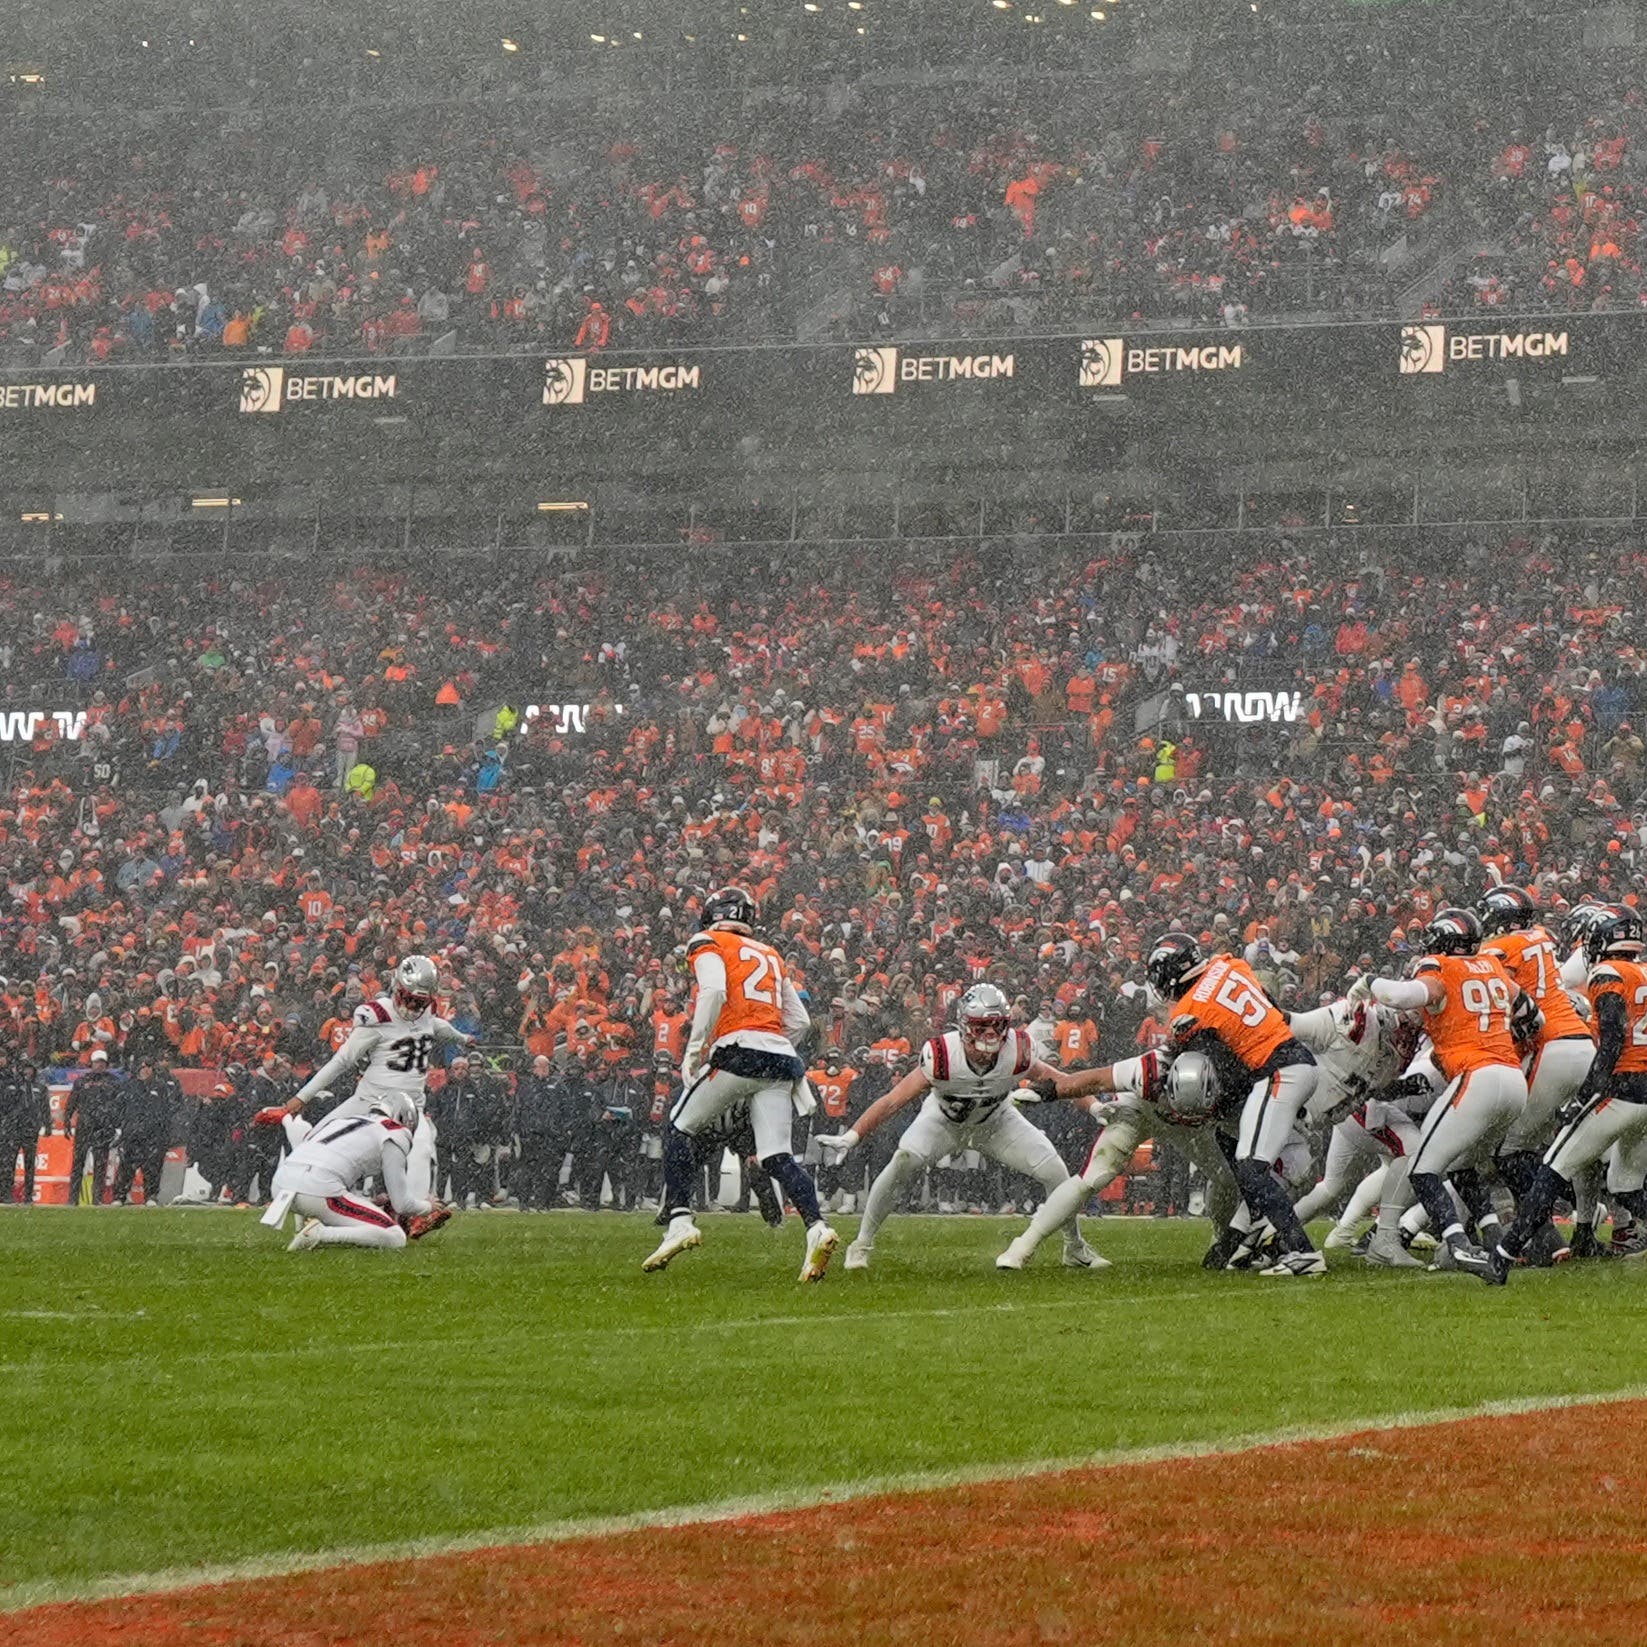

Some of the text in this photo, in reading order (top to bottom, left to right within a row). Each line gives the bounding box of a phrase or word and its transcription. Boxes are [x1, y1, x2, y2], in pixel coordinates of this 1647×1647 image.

[1449, 331, 1568, 359] BETMGM
[901, 355, 1014, 381] BETMGM
[1127, 344, 1242, 373] BETMGM
[286, 373, 396, 400] BETMGM
[590, 365, 699, 392] BETMGM
[1103, 668, 1116, 681] 15
[983, 707, 991, 719] 2
[307, 901, 321, 916] 10
[729, 906, 743, 919] 21
[739, 946, 783, 1009] 21
[1462, 977, 1511, 1031] 99
[658, 1023, 669, 1041] 2
[1069, 1029, 1081, 1049] 2
